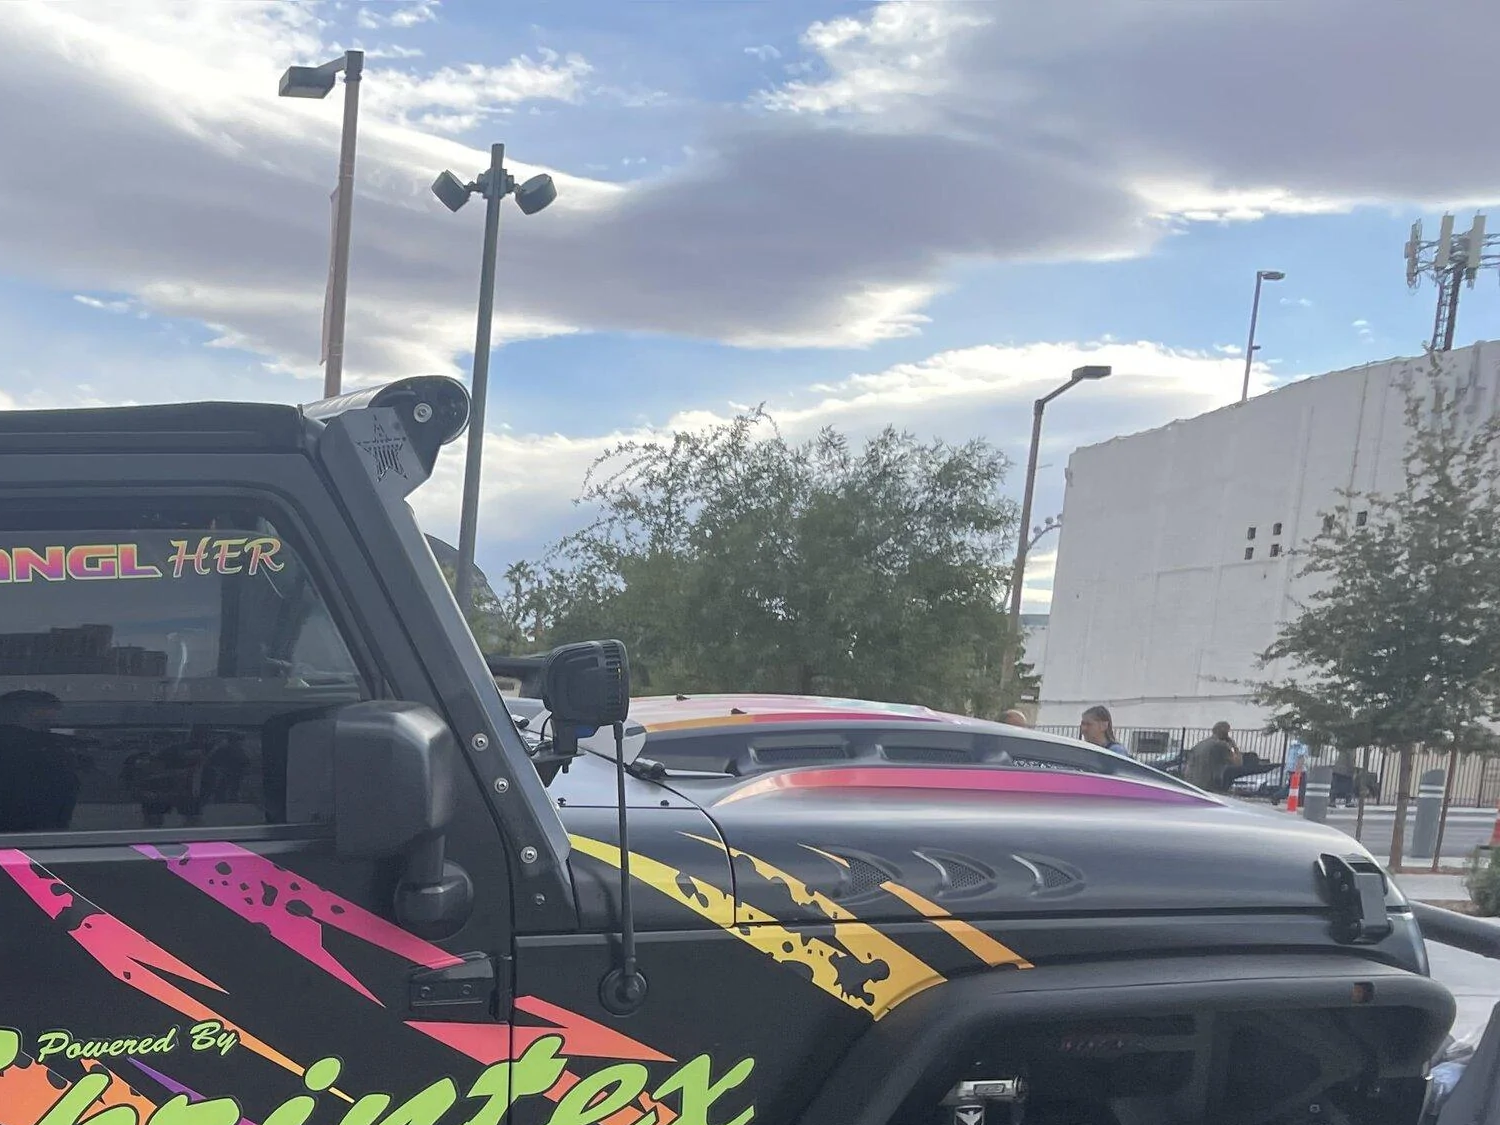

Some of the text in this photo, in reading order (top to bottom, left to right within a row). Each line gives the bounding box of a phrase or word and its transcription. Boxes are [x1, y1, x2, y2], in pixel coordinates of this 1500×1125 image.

[167, 536, 286, 579] HER
[37, 1021, 238, 1063] Powered By
